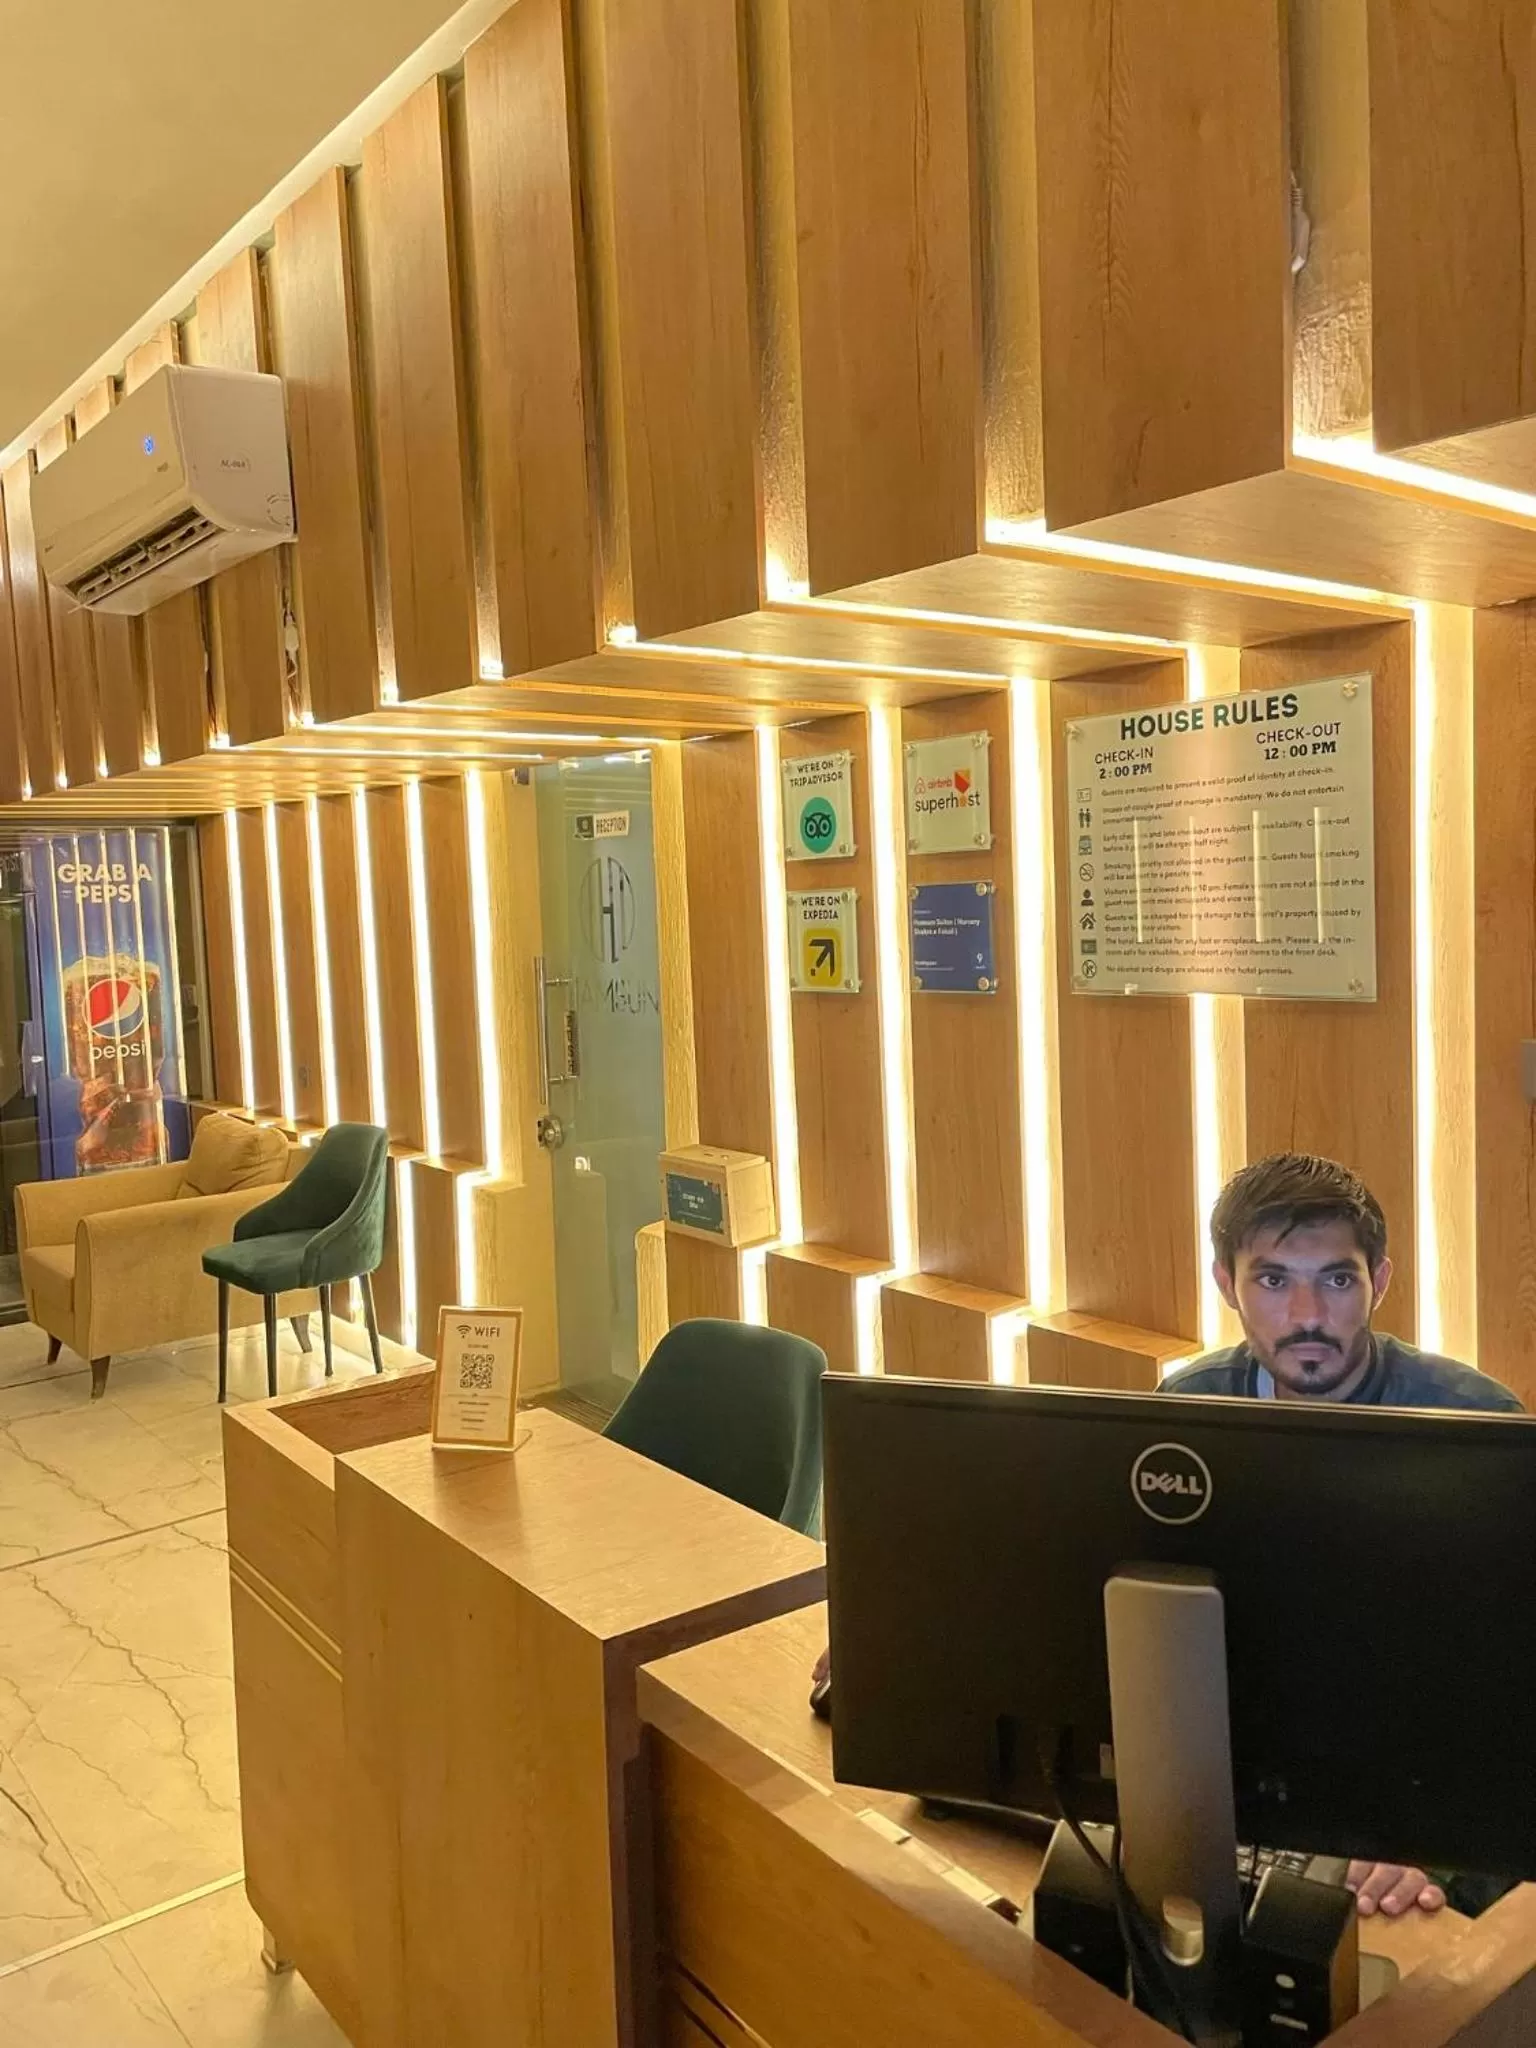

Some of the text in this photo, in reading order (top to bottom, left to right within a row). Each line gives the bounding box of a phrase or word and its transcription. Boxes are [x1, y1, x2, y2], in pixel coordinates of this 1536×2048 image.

[1120, 693, 1298, 740] HOUSE RULES
[1256, 722, 1342, 744] CHECK-OUT
[1095, 746, 1153, 764] CHECK-IN
[1312, 741, 1336, 755] PM
[821, 760, 834, 770] ON
[1132, 763, 1152, 775] PM
[790, 771, 843, 787] TRIPADVISOR
[1226, 774, 1245, 785] proof
[1256, 770, 1285, 782] identity
[1308, 784, 1344, 795] entertain
[915, 790, 980, 814] superhost
[58, 863, 152, 883] GRAB A
[826, 896, 840, 906] ON
[803, 910, 838, 920] EXPEDIA
[90, 1040, 145, 1064] pepsi
[474, 1326, 500, 1338] WIFI
[1140, 1472, 1203, 1496] DELL
